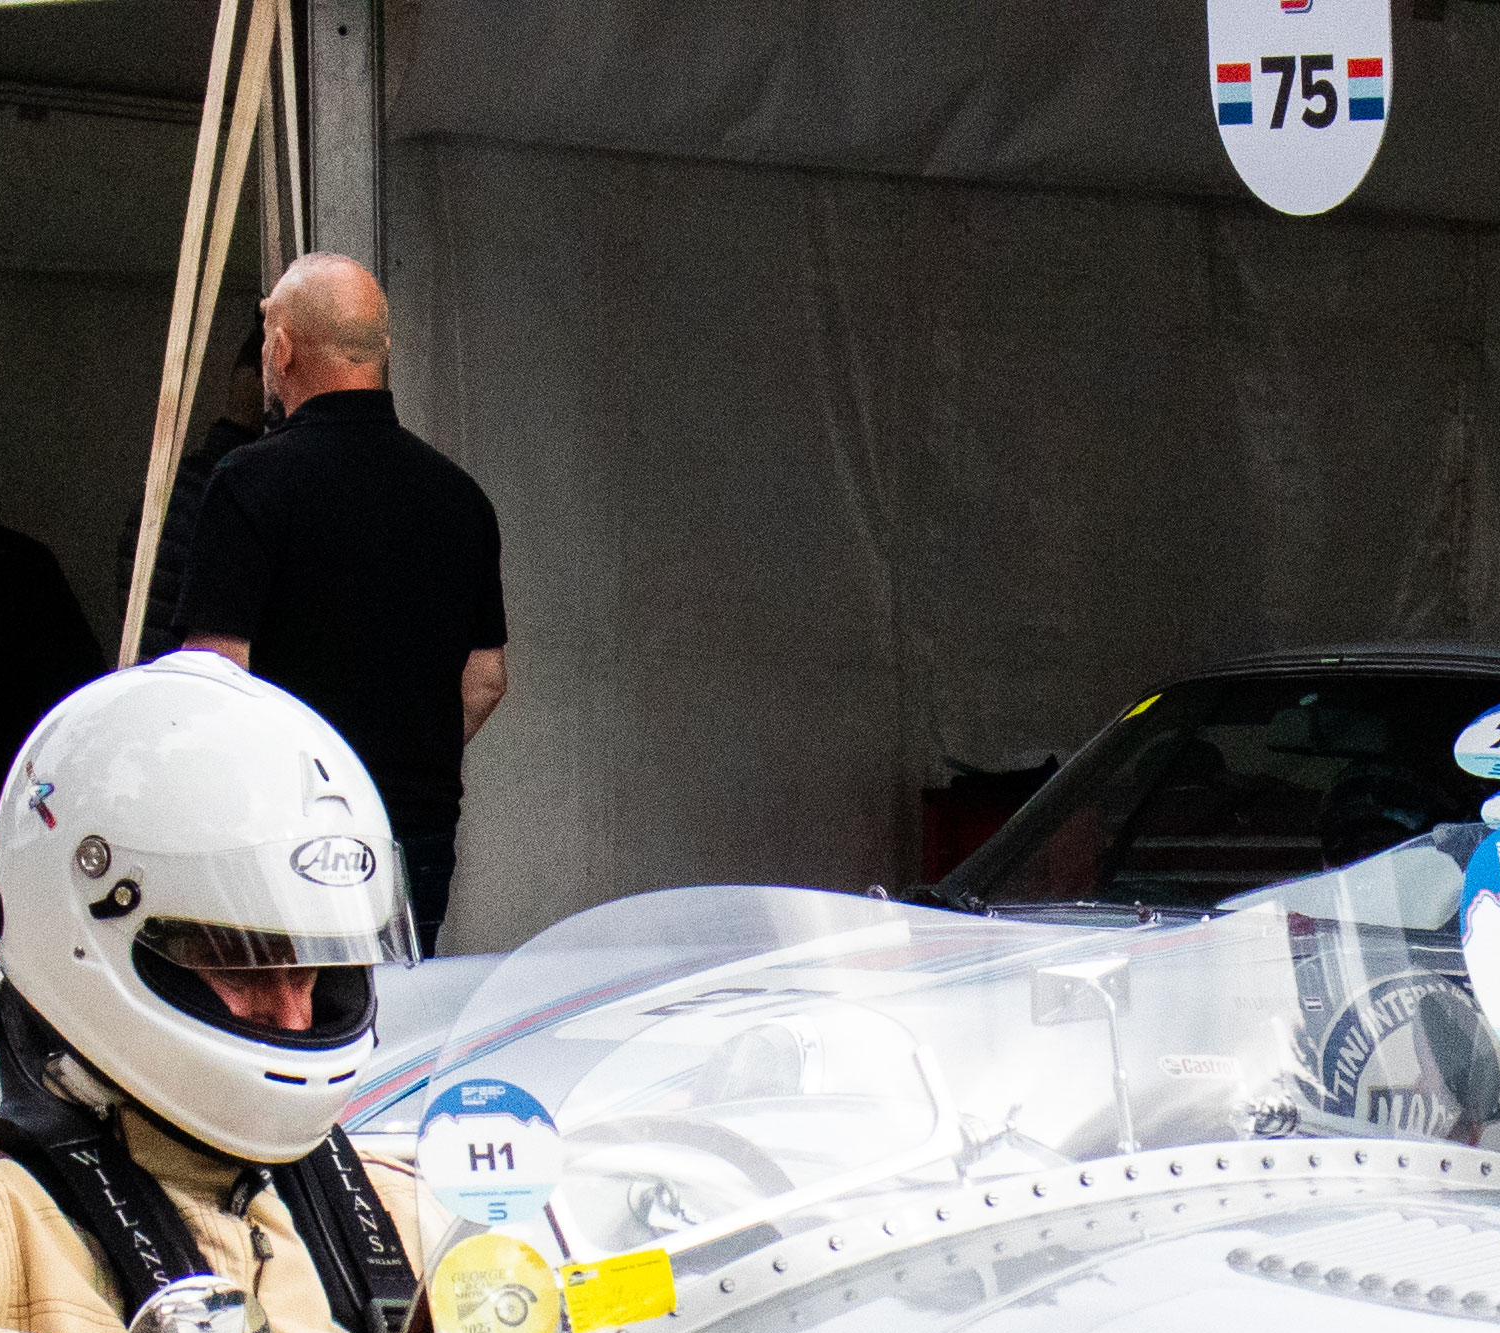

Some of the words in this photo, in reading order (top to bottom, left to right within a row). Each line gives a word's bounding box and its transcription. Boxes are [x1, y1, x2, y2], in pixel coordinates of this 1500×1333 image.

[1261, 54, 1339, 129] 75
[299, 841, 369, 874] Arai
[1181, 1057, 1234, 1074] Castrol
[468, 1142, 516, 1171] H1
[326, 1137, 386, 1254] ILLANS
